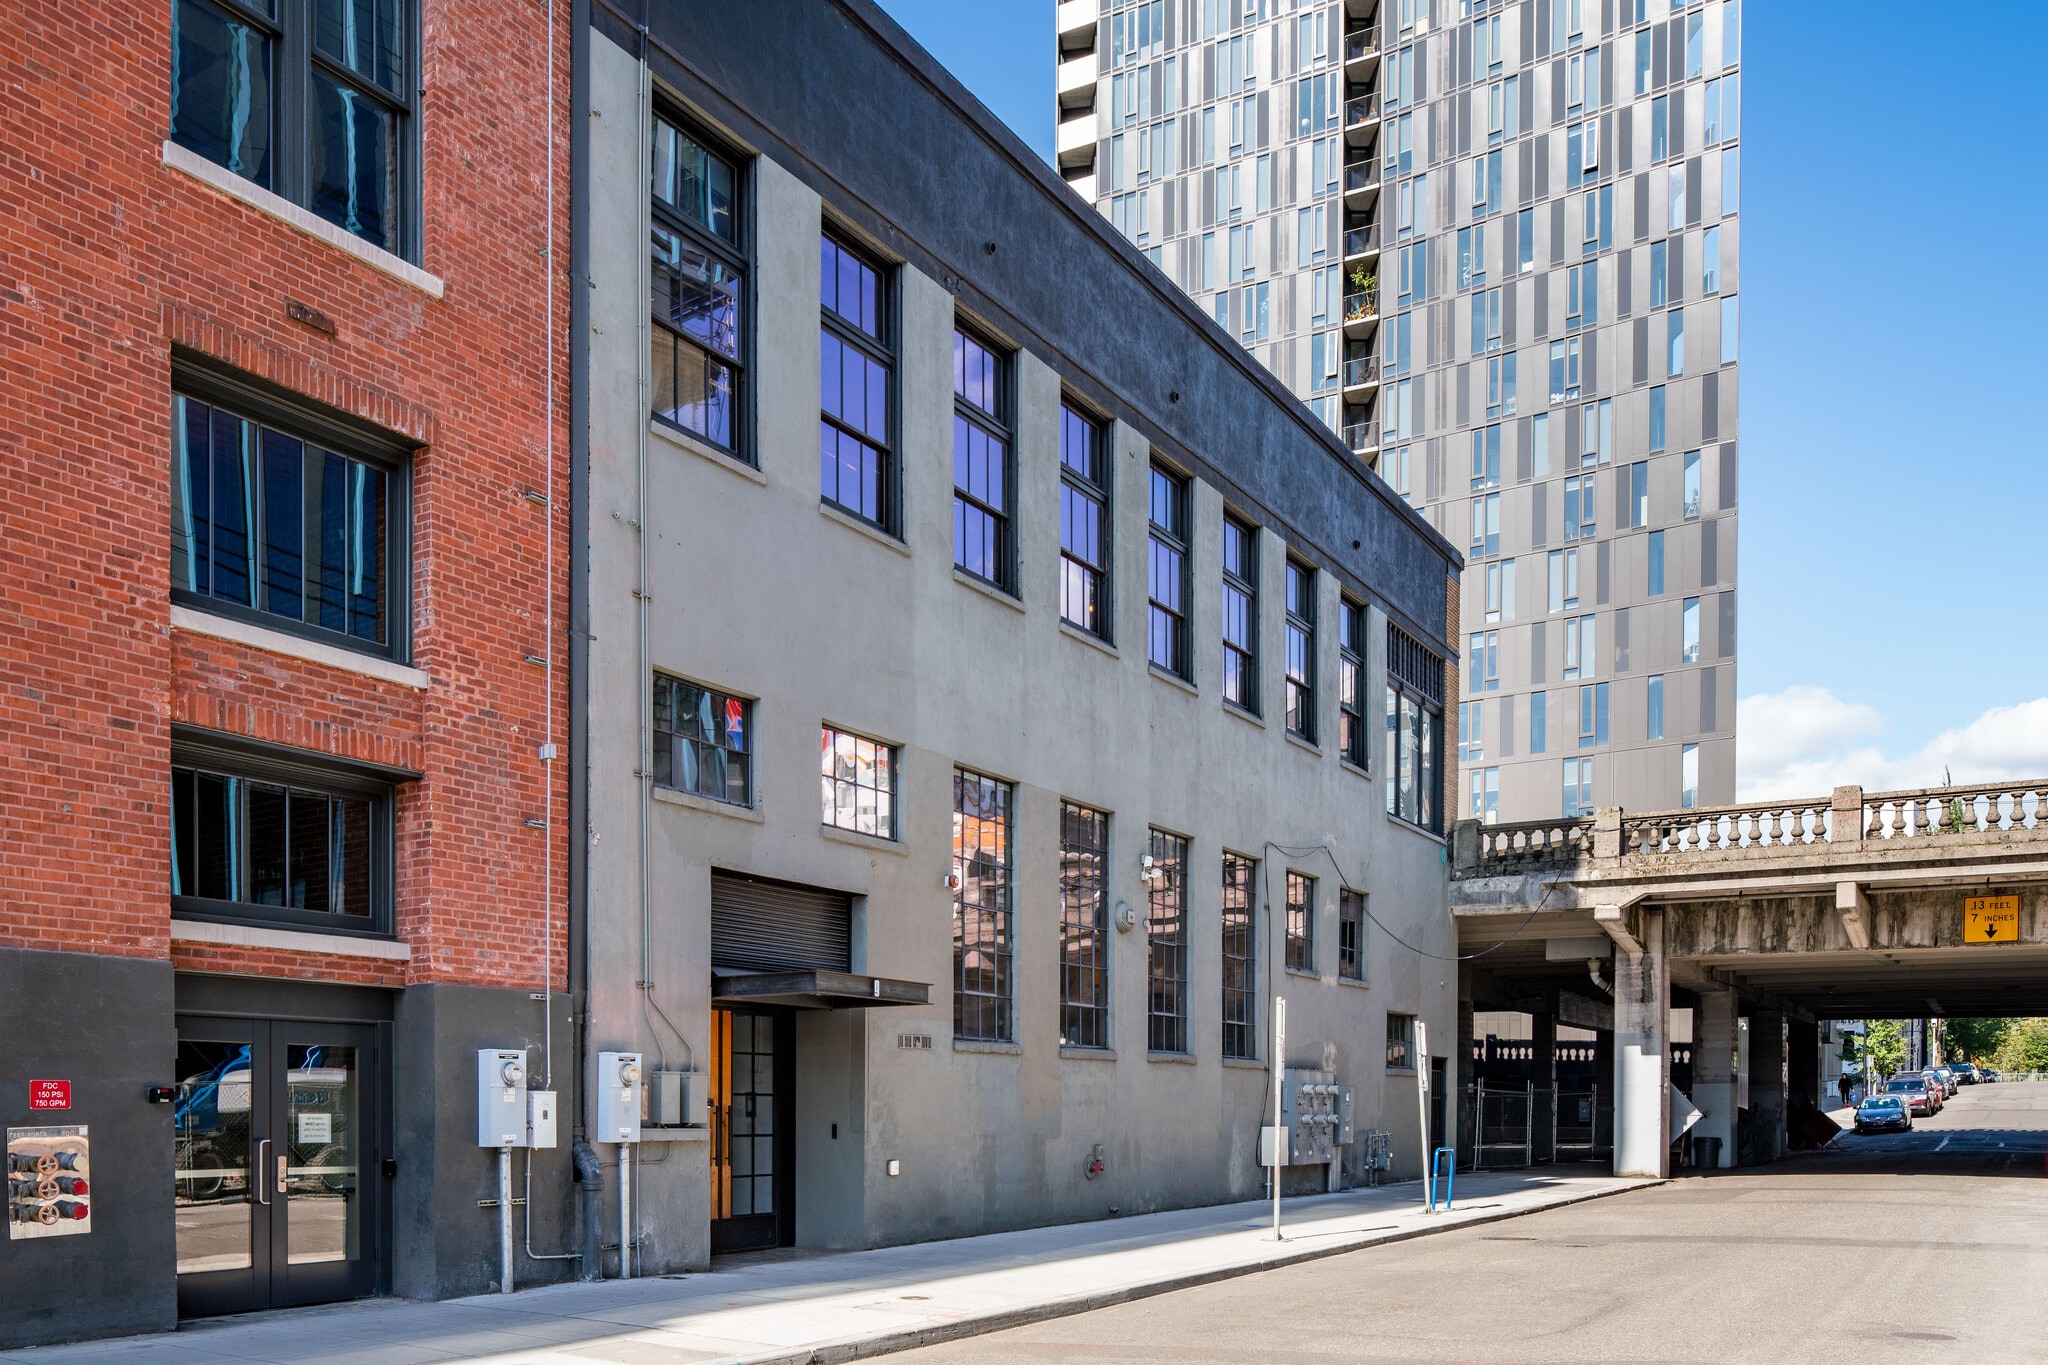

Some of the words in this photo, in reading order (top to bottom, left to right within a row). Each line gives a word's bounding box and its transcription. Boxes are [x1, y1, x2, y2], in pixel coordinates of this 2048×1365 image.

[1973, 901, 1985, 911] 13
[1989, 902, 2010, 910] FEET
[1971, 914, 1978, 923] 7
[1984, 914, 2015, 922] INCHES
[874, 980, 880, 997] 9
